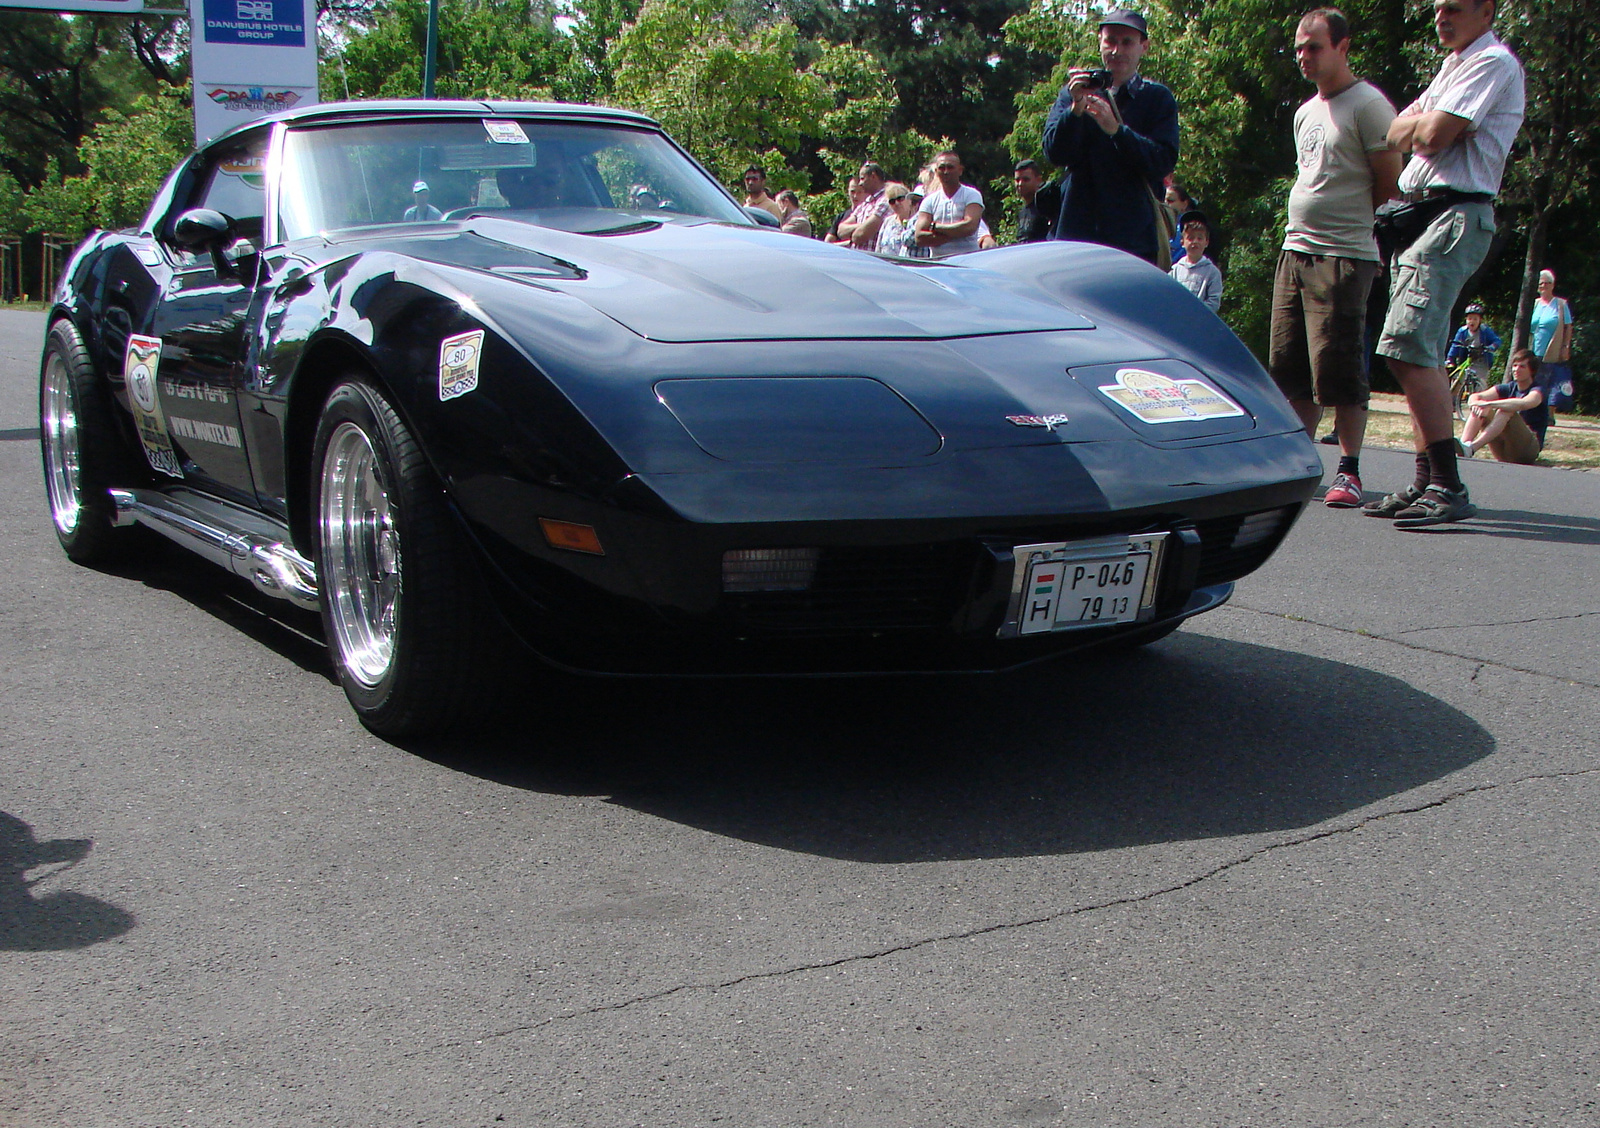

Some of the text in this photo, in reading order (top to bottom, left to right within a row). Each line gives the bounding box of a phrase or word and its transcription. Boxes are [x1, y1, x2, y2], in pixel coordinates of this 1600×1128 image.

[207, 20, 303, 32] DANUBIUS HOTELS
[238, 31, 274, 39] GROUP
[1071, 562, 1135, 590] P-046
[1030, 598, 1051, 622] H
[1080, 597, 1128, 620] 79 13
